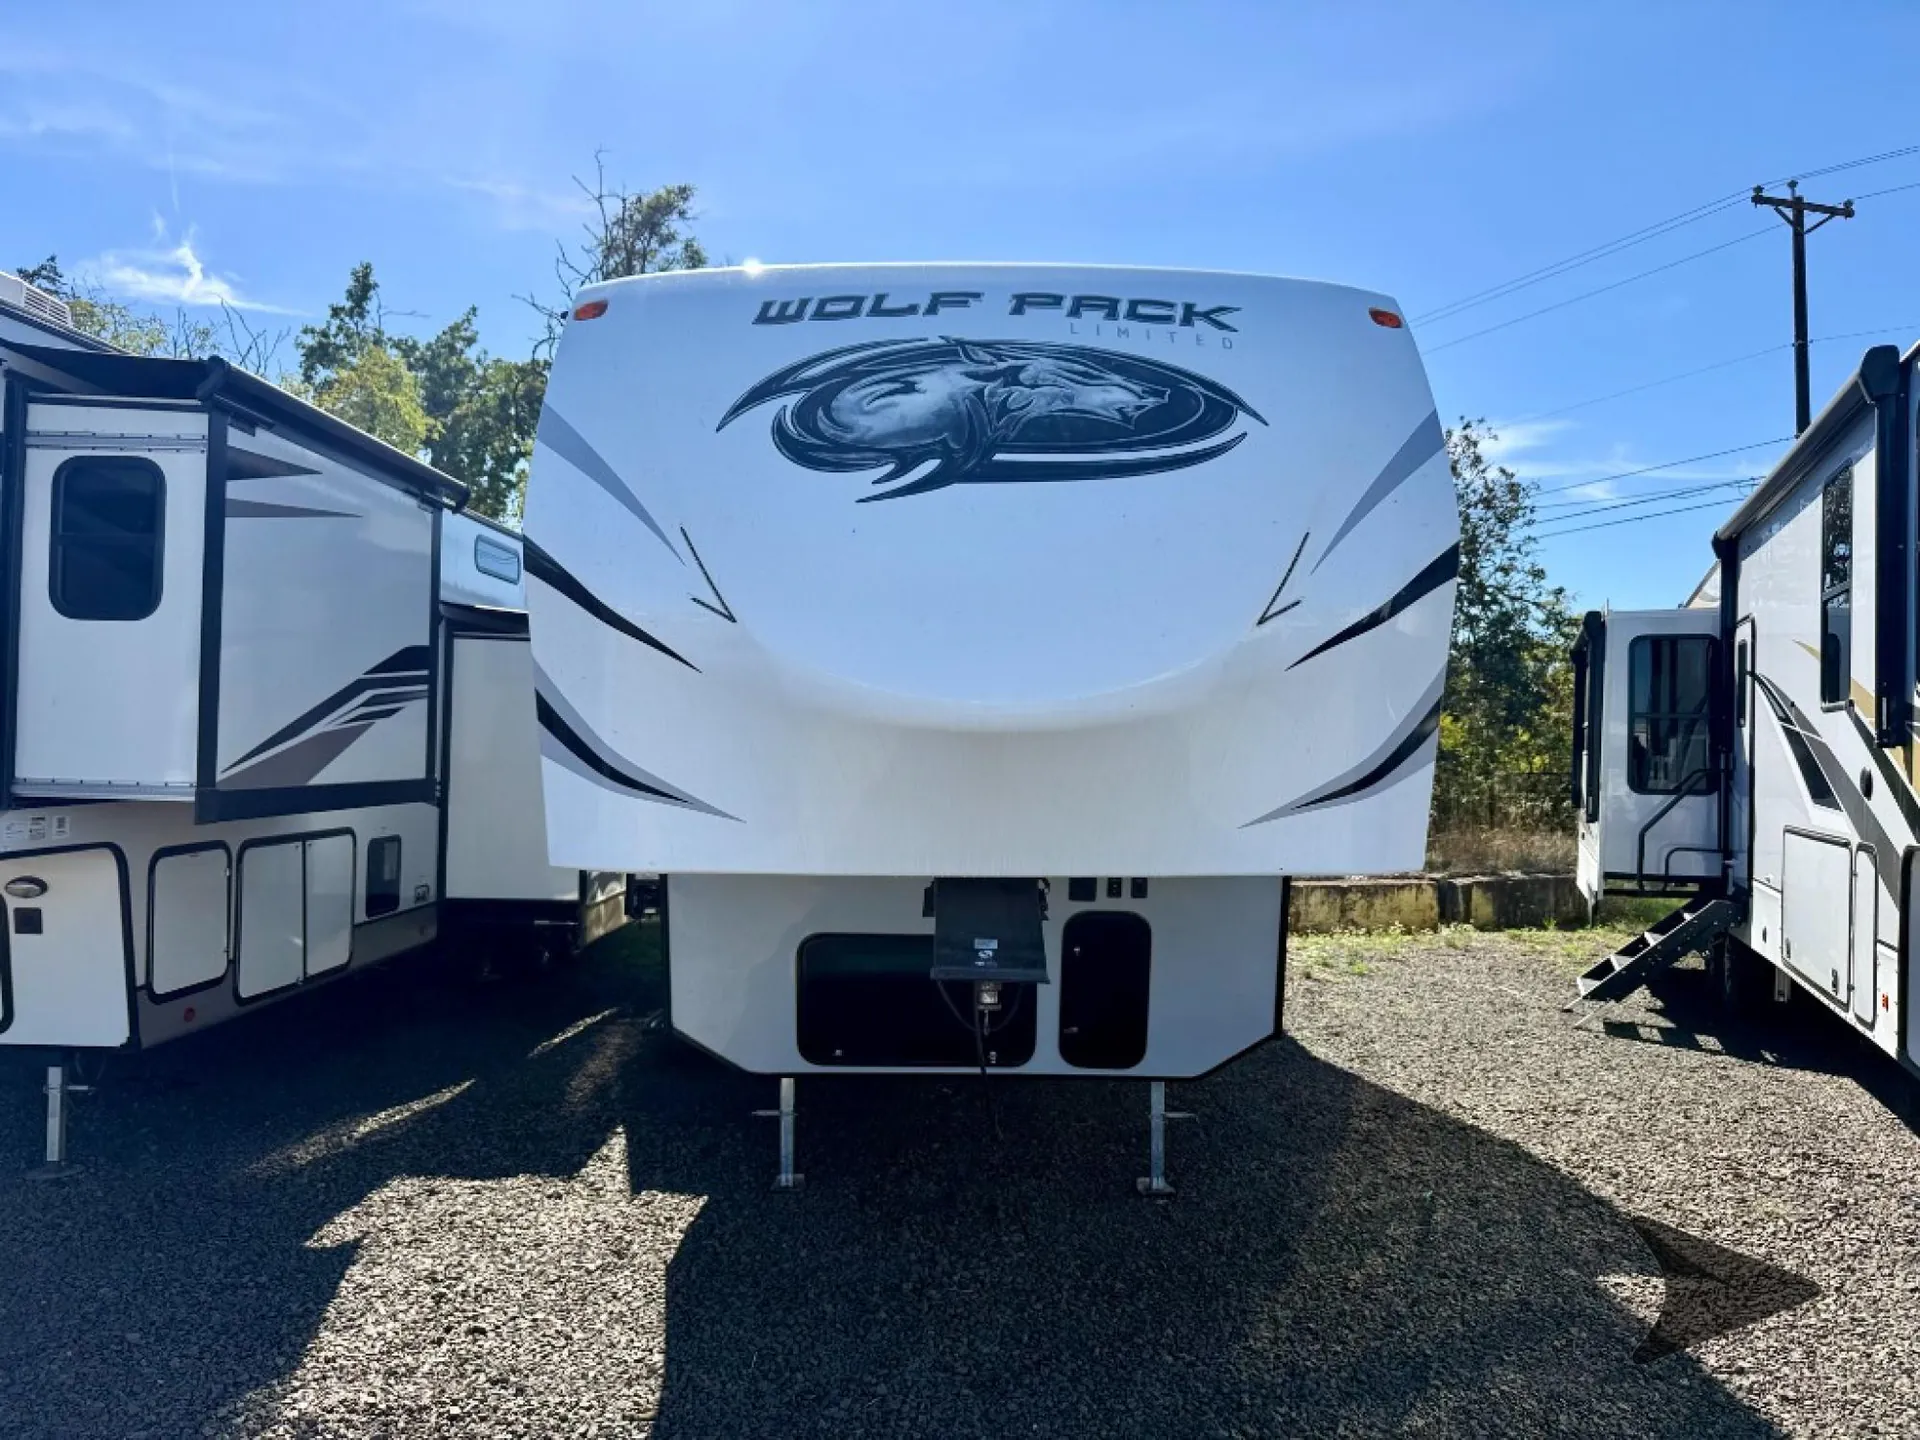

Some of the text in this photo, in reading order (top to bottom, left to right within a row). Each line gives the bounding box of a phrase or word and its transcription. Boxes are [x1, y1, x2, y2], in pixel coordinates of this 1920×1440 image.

[752, 292, 1242, 332] WOLF PACK
[1070, 322, 1233, 350] LIMITED
